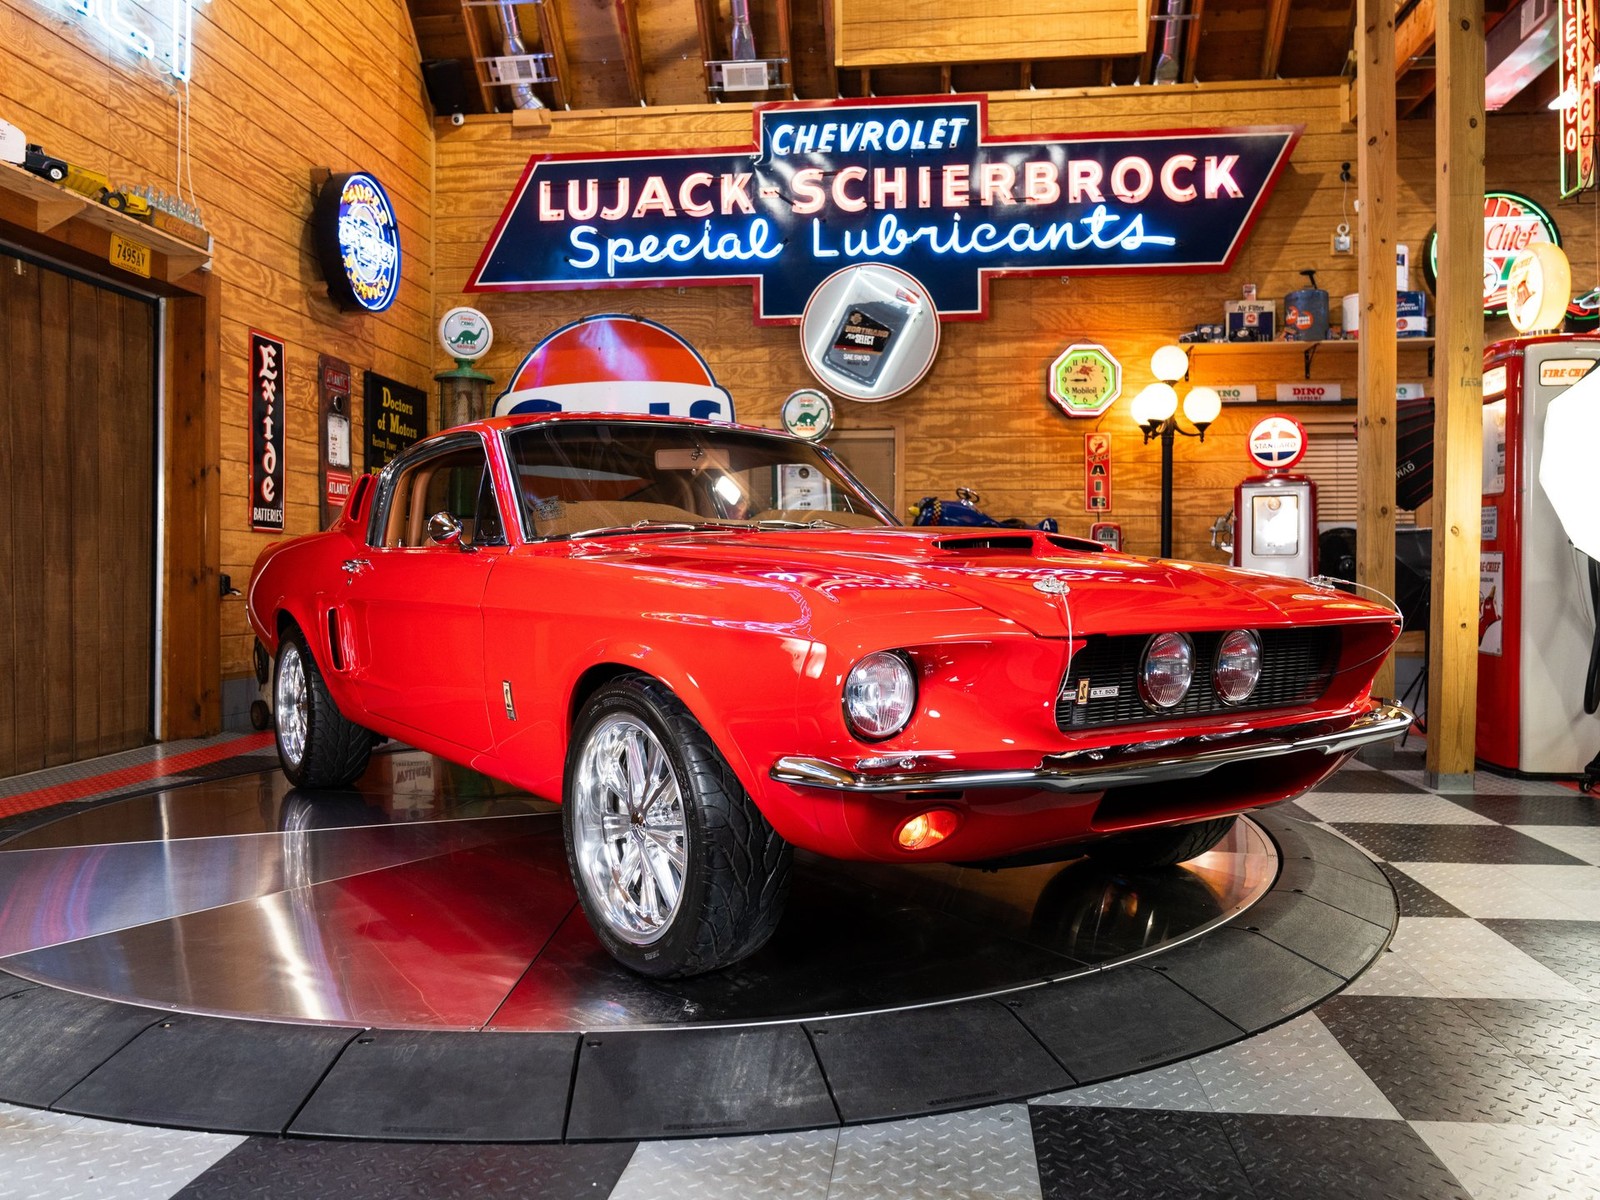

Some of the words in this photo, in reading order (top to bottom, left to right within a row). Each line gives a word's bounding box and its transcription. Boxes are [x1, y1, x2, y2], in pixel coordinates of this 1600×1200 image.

[771, 117, 970, 155] CHEVROLET
[568, 213, 784, 277] Special
[812, 204, 1177, 259] Lubricants
[1486, 222, 1539, 252] Chief
[117, 243, 145, 268] 7495AV
[1543, 368, 1589, 378] FIRE-CHI
[382, 387, 413, 415] Doctors
[1072, 387, 1097, 395] Mobiloil
[1292, 387, 1325, 396] DINO
[259, 344, 277, 502] Exide
[377, 413, 386, 431] of
[390, 413, 418, 439] Motors
[328, 481, 350, 495] ATLANTIC
[253, 507, 283, 523] BATTERIES
